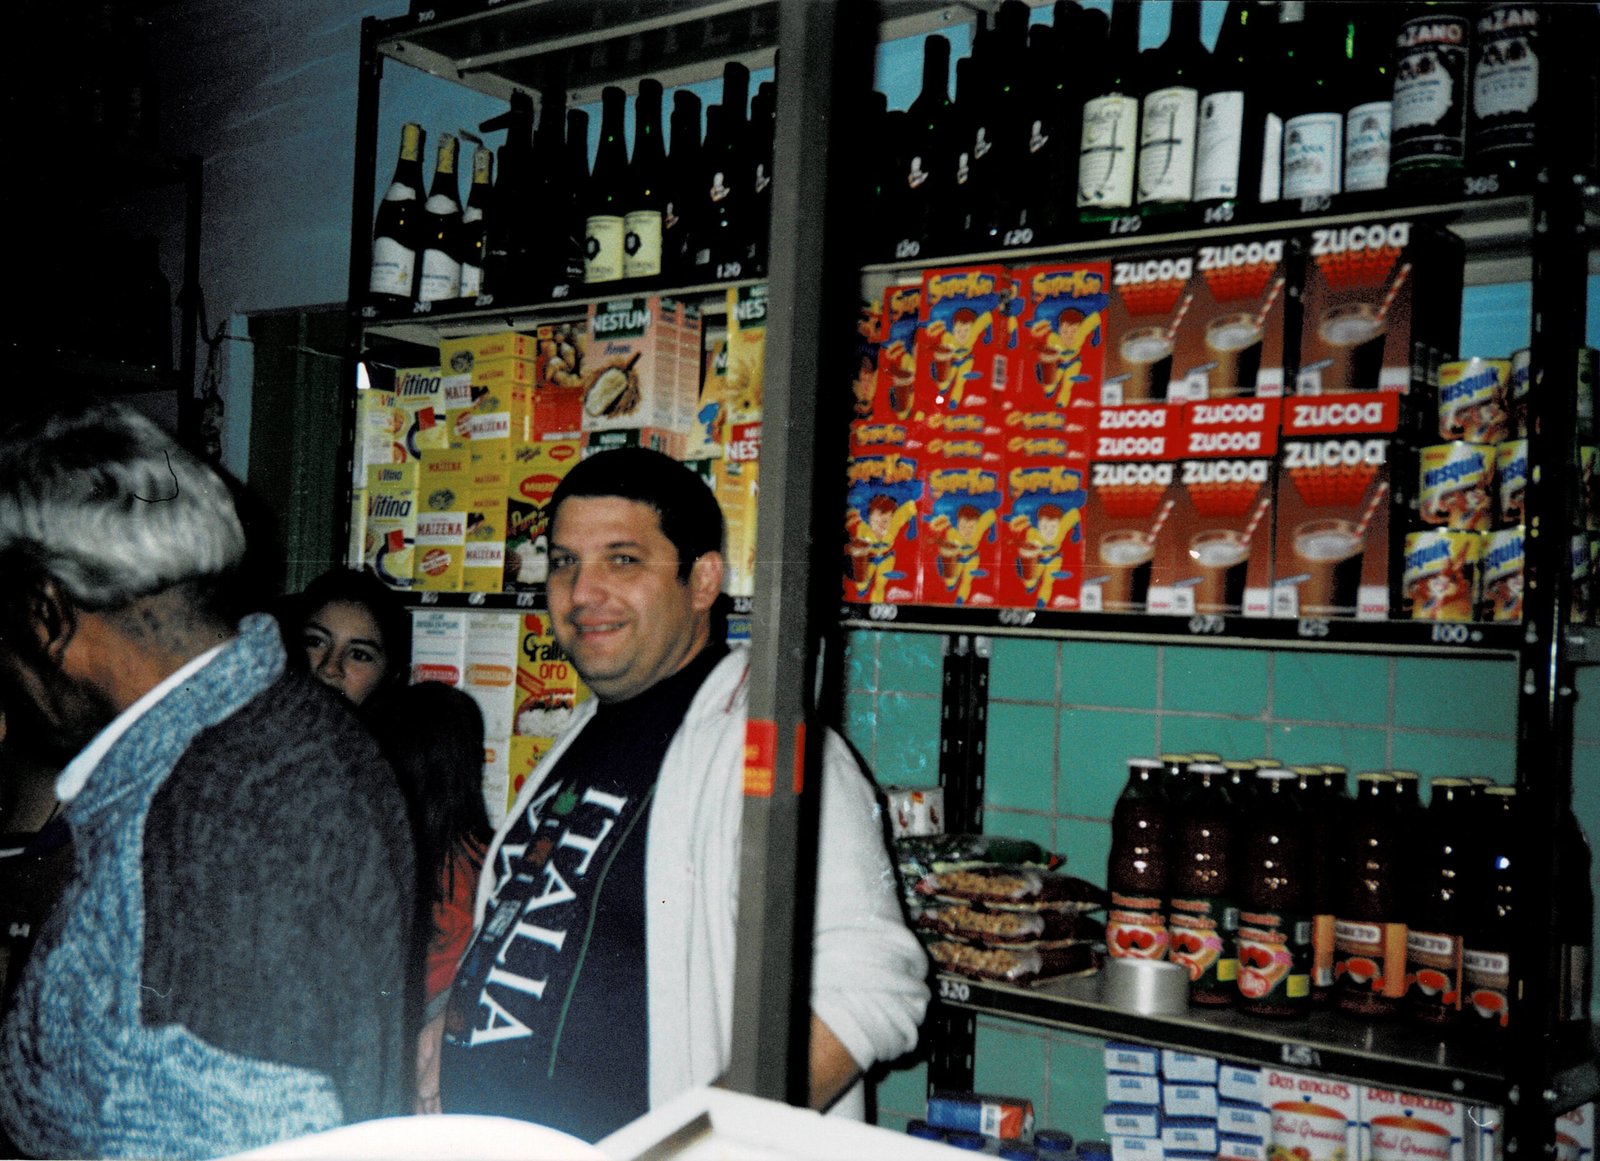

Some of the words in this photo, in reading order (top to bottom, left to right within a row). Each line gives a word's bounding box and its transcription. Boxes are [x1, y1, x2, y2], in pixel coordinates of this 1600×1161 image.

[1003, 228, 1034, 246] 120
[717, 262, 741, 279] 120
[592, 309, 652, 333] NESTUM
[394, 371, 442, 397] Vitina
[428, 461, 463, 473] MAIZENA
[367, 493, 413, 518] Vitina
[417, 521, 463, 536] MAIZENA
[466, 549, 502, 560] MAIZENA
[1432, 624, 1469, 643] 100
[540, 663, 568, 681] oro
[470, 787, 629, 1047] ITALIA
[938, 982, 970, 1001] 320
